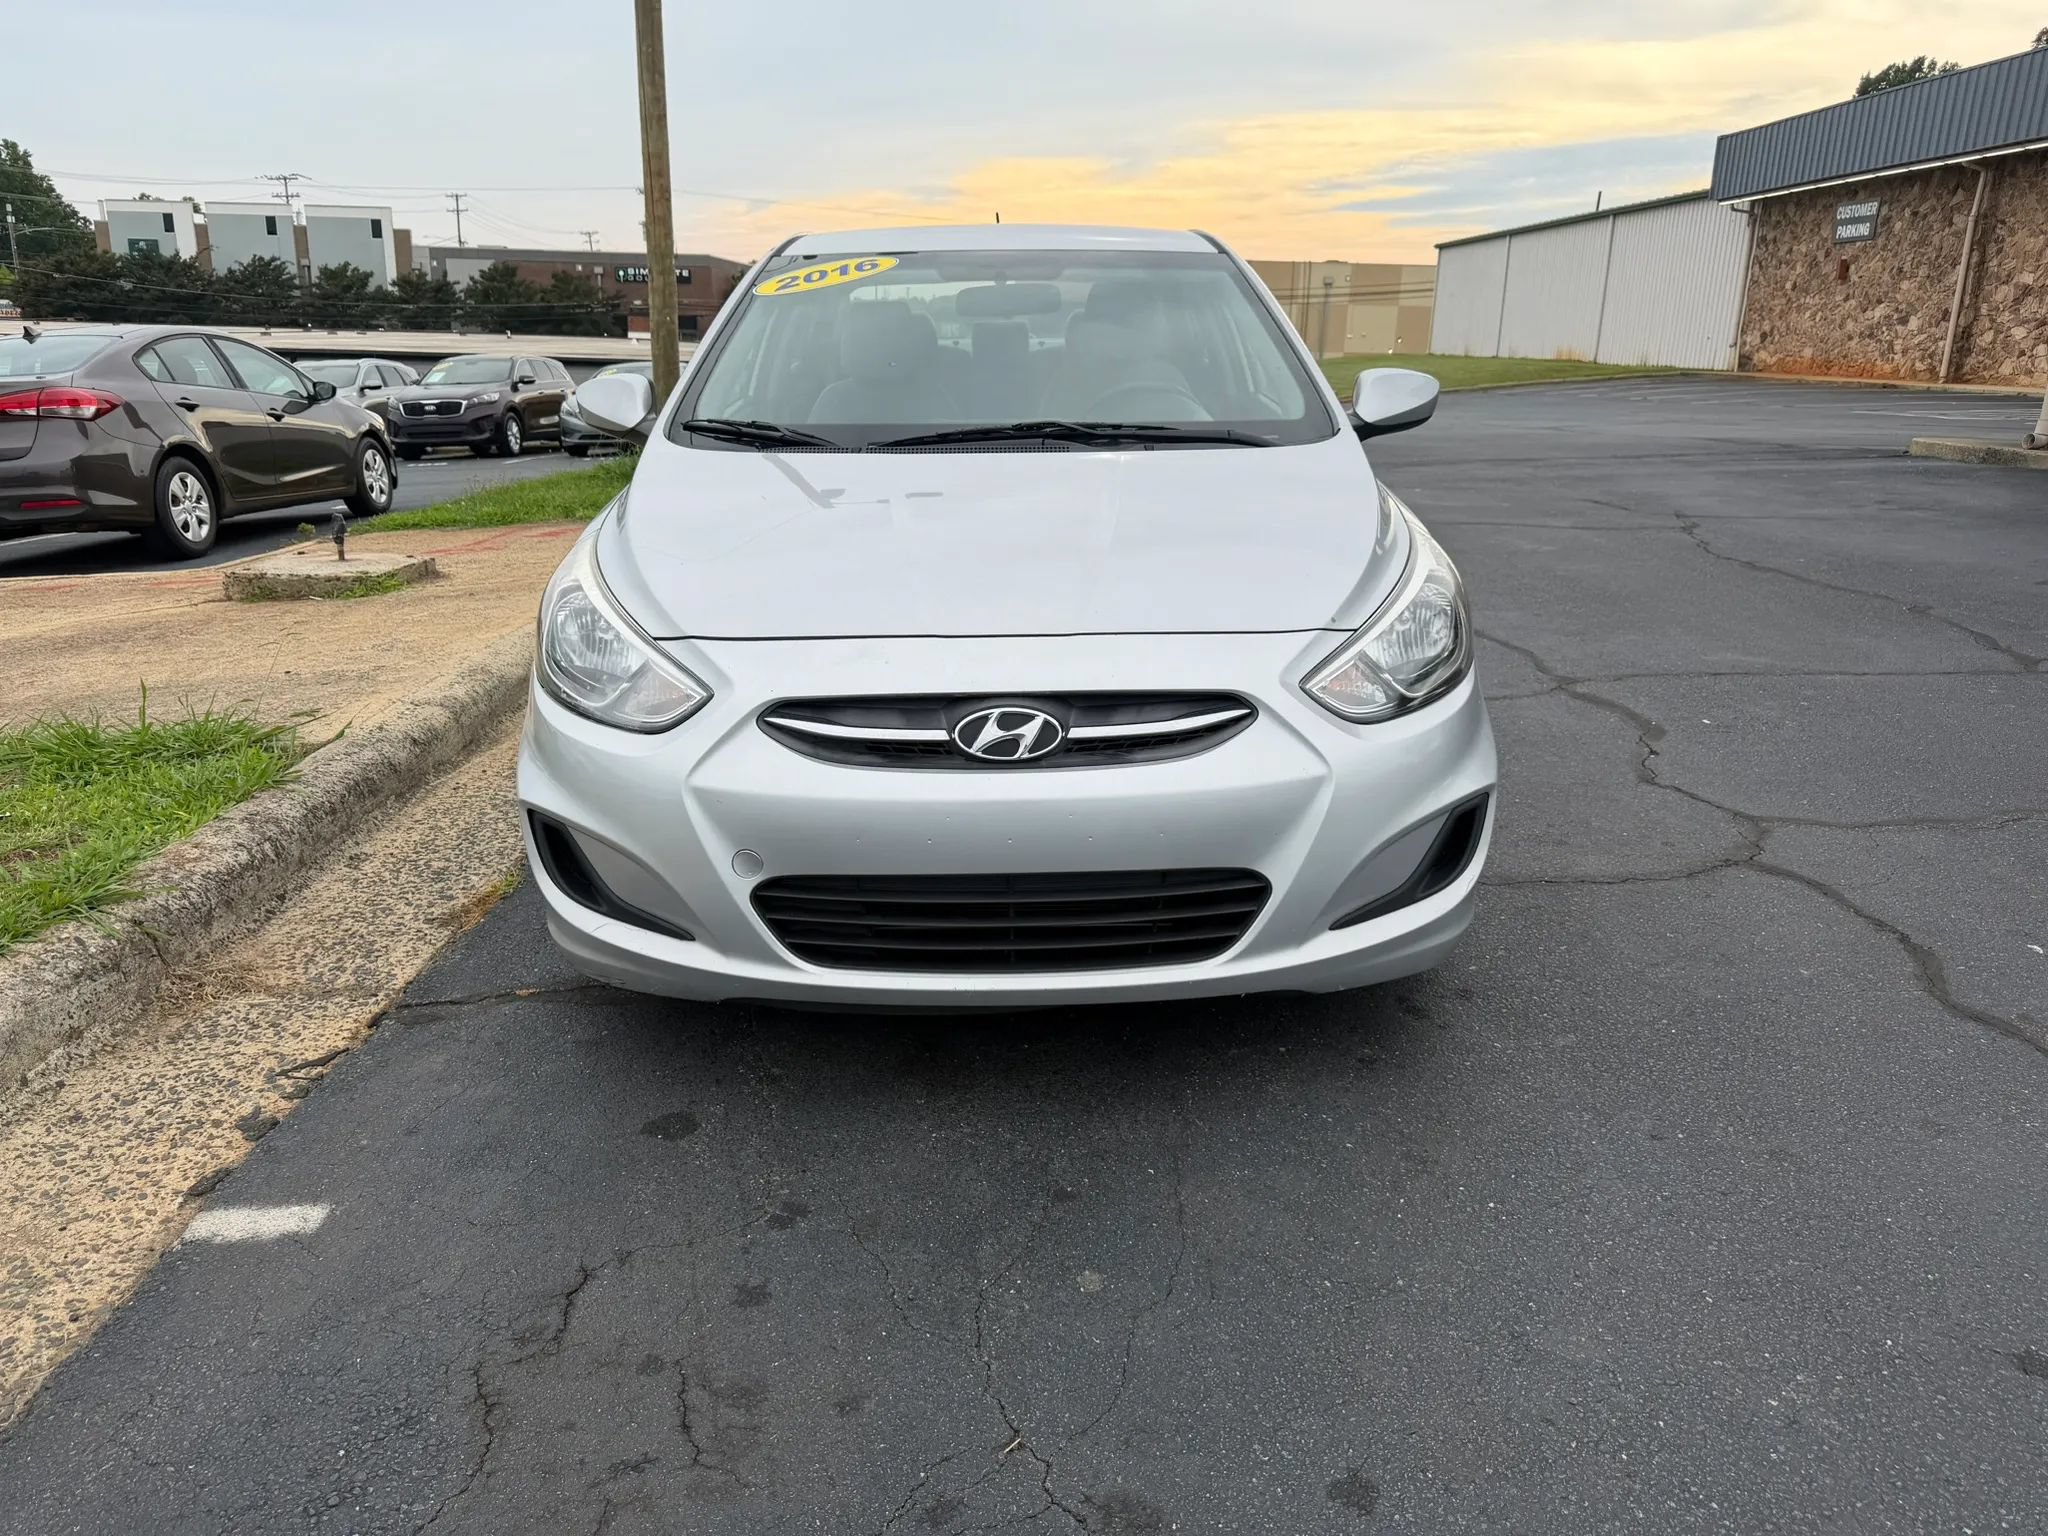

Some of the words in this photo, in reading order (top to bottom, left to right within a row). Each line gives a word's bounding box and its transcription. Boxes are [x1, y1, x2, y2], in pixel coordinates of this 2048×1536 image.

[1836, 201, 1878, 219] CUSTOMER
[1836, 222, 1870, 239] PARKING
[774, 259, 881, 292] 2016
